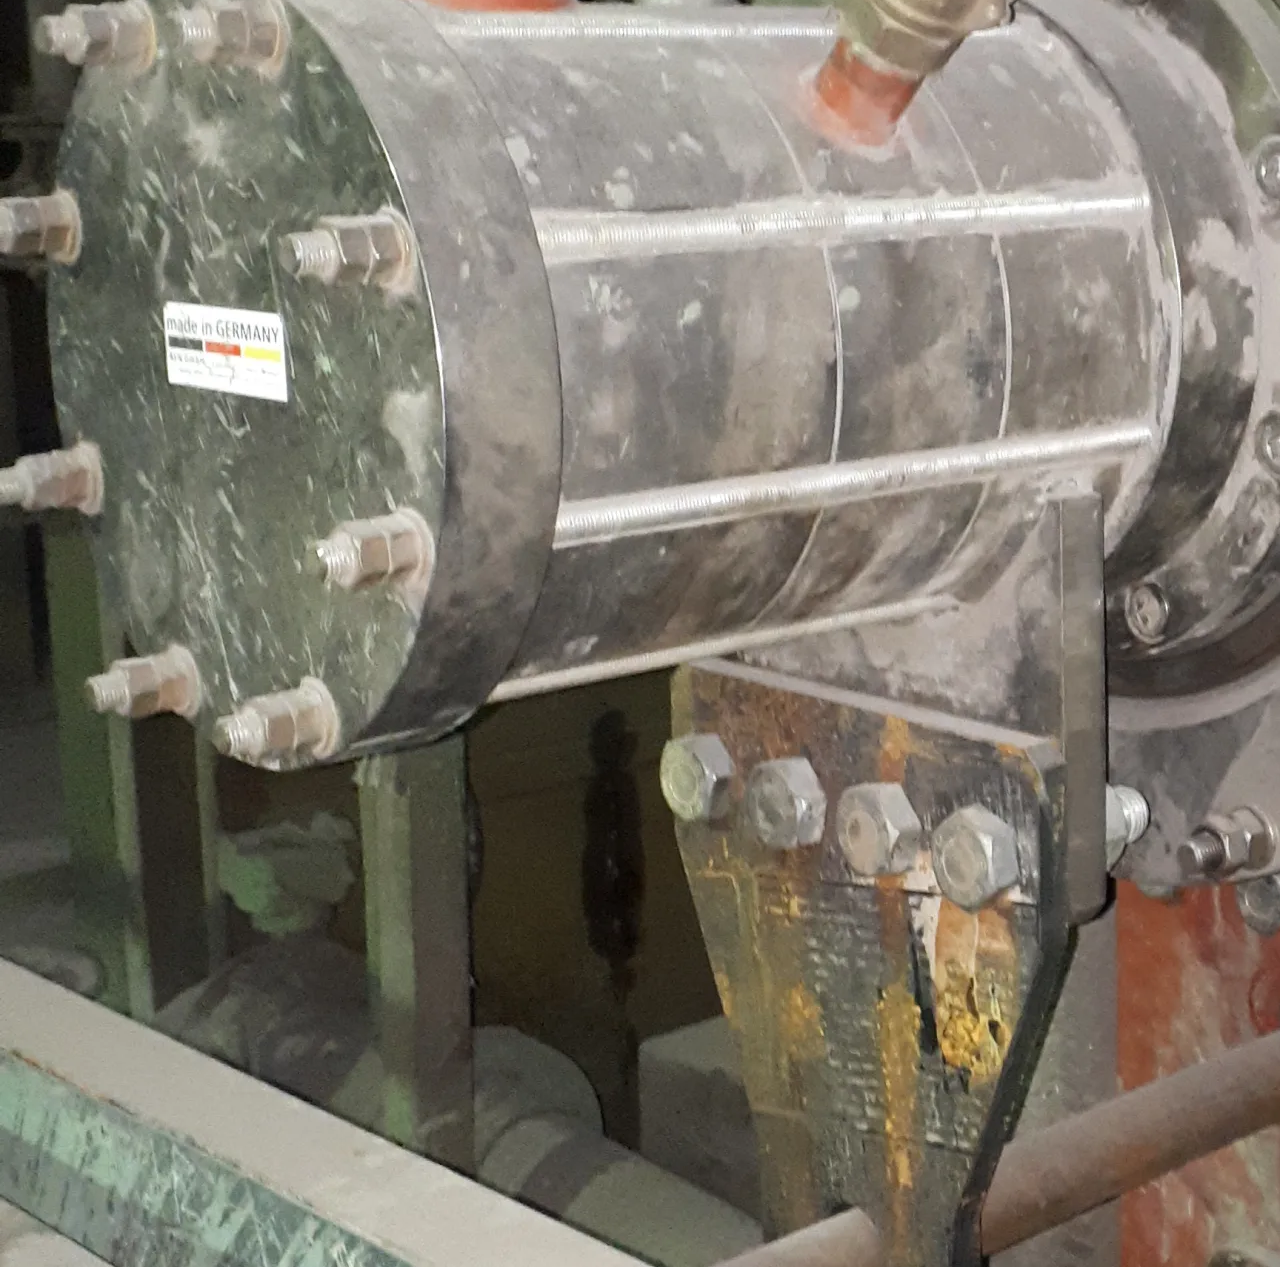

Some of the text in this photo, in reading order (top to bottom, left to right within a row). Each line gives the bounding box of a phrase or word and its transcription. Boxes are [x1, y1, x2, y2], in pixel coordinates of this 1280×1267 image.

[166, 315, 280, 345] made in GERMANY
